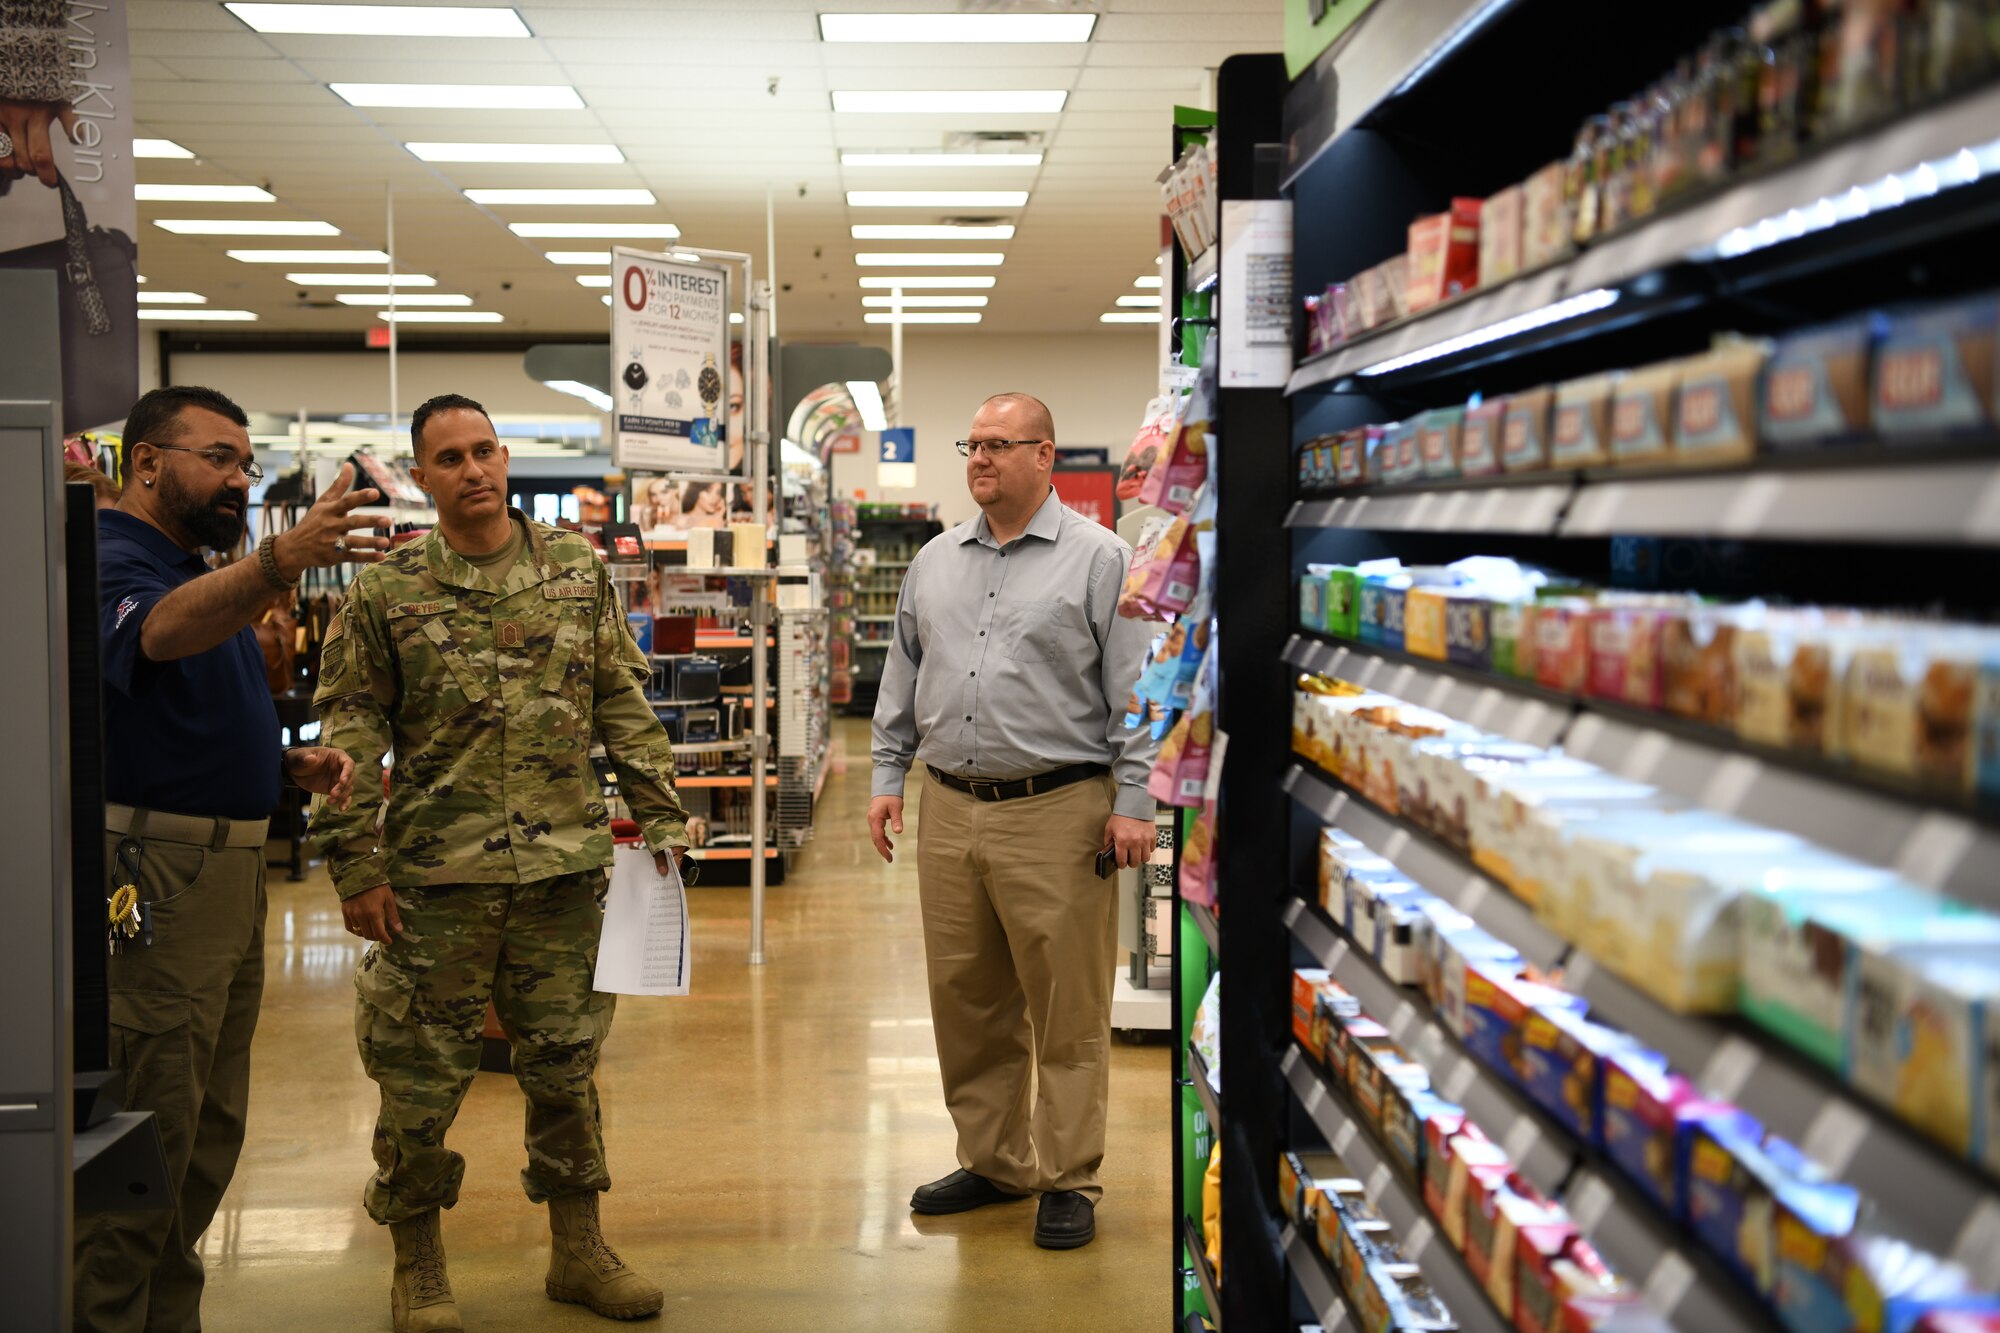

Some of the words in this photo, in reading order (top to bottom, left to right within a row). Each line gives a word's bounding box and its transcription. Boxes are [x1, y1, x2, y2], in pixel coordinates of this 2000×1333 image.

[70, 80, 118, 183] Klein
[657, 270, 720, 296] INTEREST
[657, 290, 673, 303] NO
[674, 292, 720, 311] PAYMENTS
[648, 302, 668, 315] FOR
[669, 304, 681, 320] 12
[682, 309, 720, 325] MONTHS
[883, 441, 897, 460] 2
[545, 587, 557, 598] US
[559, 586, 573, 597] AIR
[573, 584, 597, 597] FORCE
[407, 602, 440, 615] REYES
